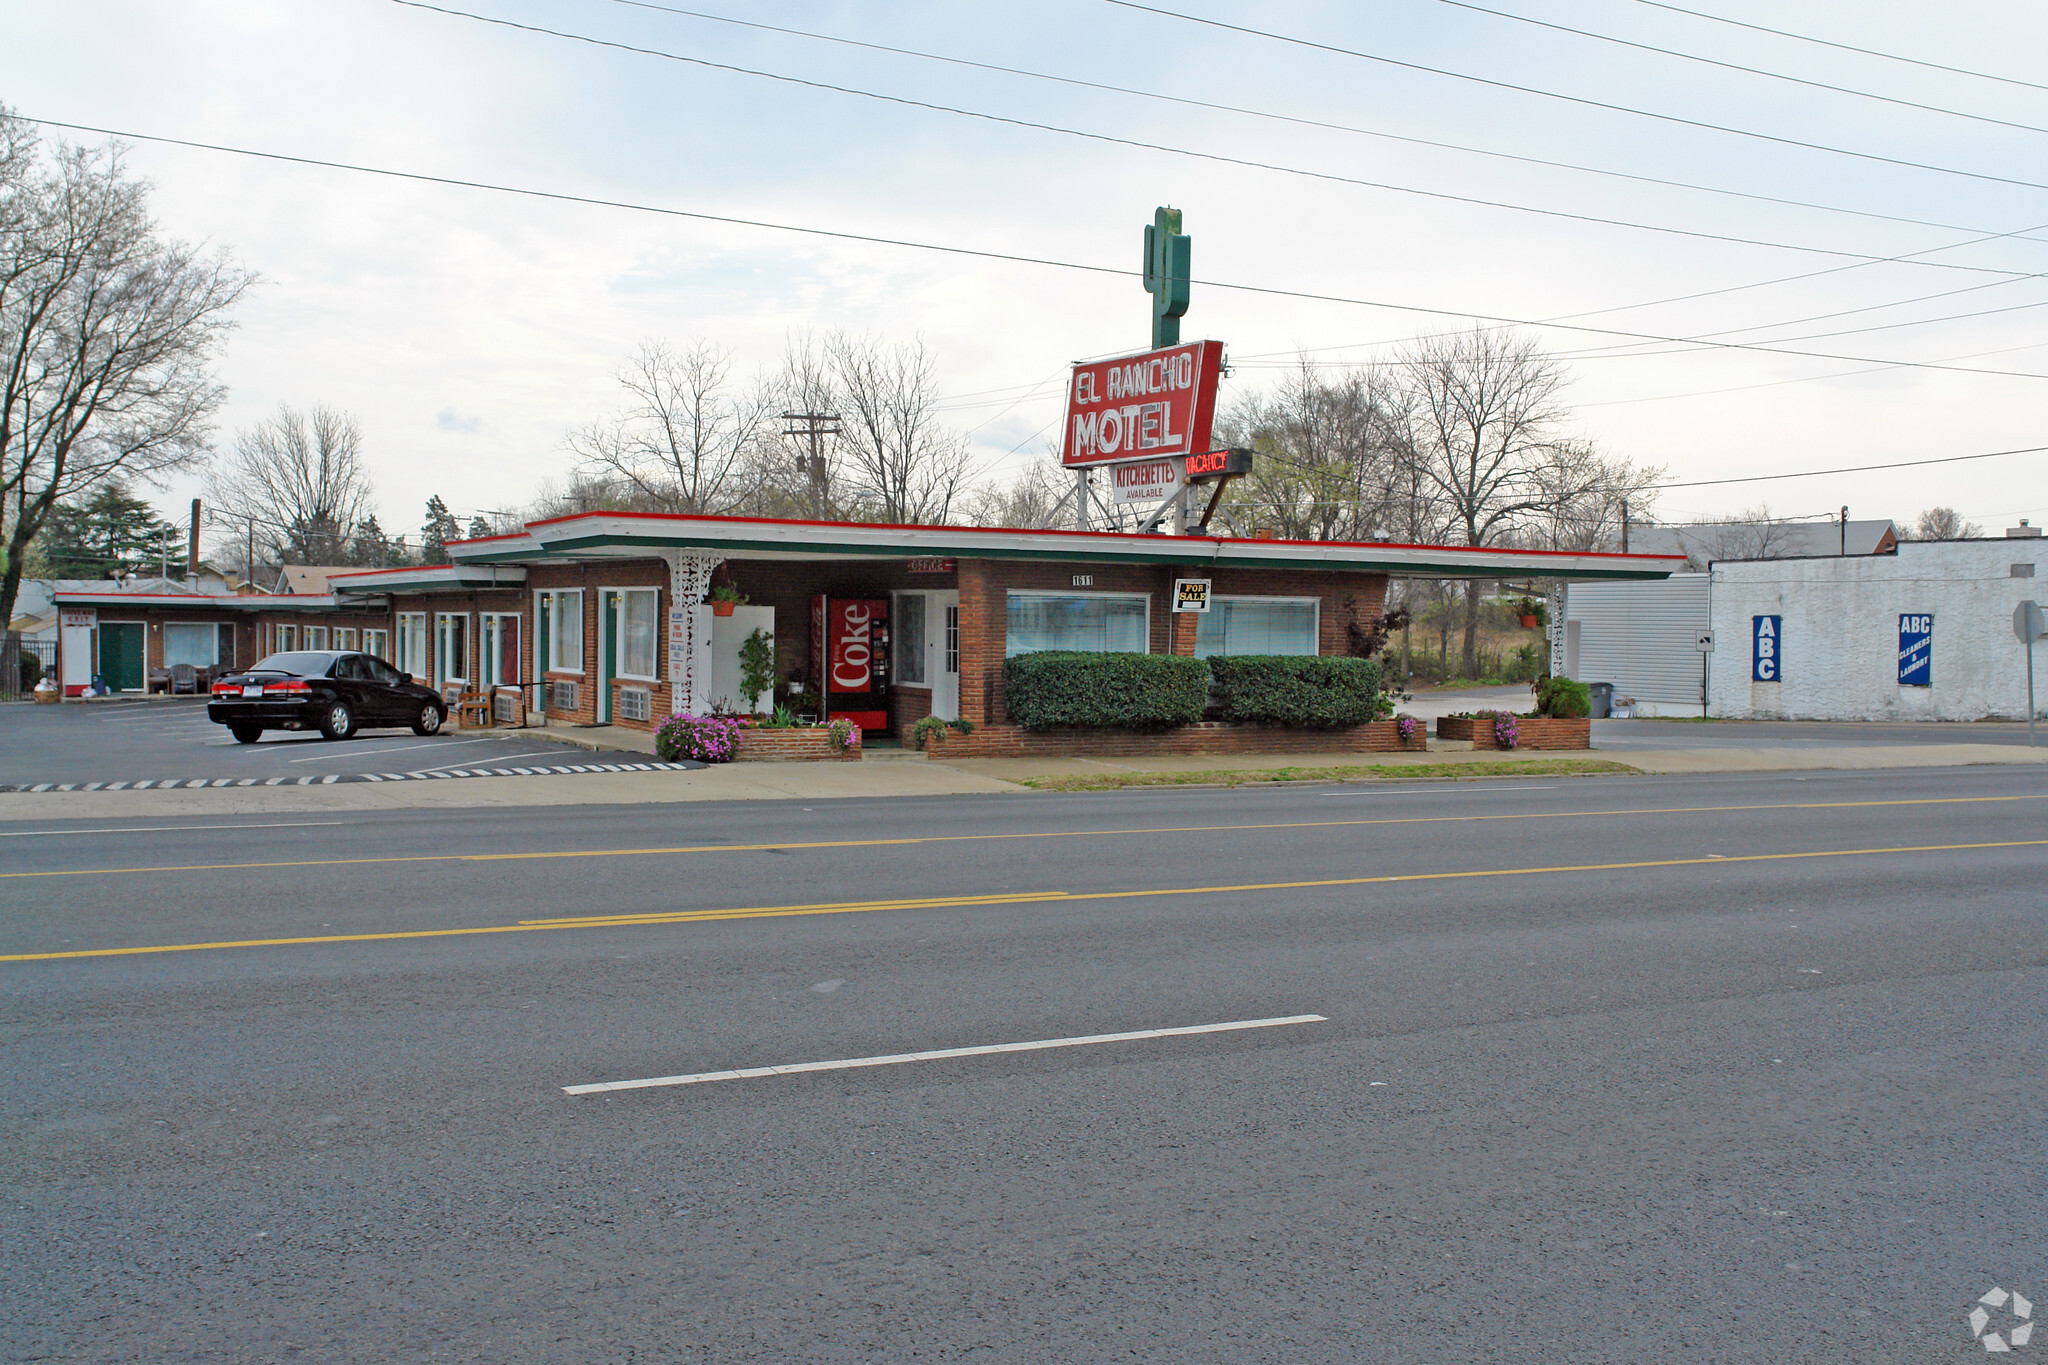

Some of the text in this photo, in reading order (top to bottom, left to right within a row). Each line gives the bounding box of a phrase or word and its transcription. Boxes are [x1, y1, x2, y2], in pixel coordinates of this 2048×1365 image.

[1076, 352, 1192, 404] EL RANCHO
[1072, 401, 1182, 456] MOTEL
[1185, 451, 1228, 474] VACANCY
[1116, 462, 1175, 488] KITCHENETTES
[1126, 488, 1163, 499] AVAILABLE
[911, 559, 943, 570] OFFICE
[1179, 592, 1207, 601] SALE
[1185, 584, 1204, 592] FOR
[1900, 616, 1930, 633] ABC
[833, 604, 870, 688] Coke
[1758, 616, 1775, 679] ABC
[1899, 635, 1931, 660] CLEANERS
[1911, 653, 1918, 662] &
[1900, 655, 1929, 678] LAUNDRY
